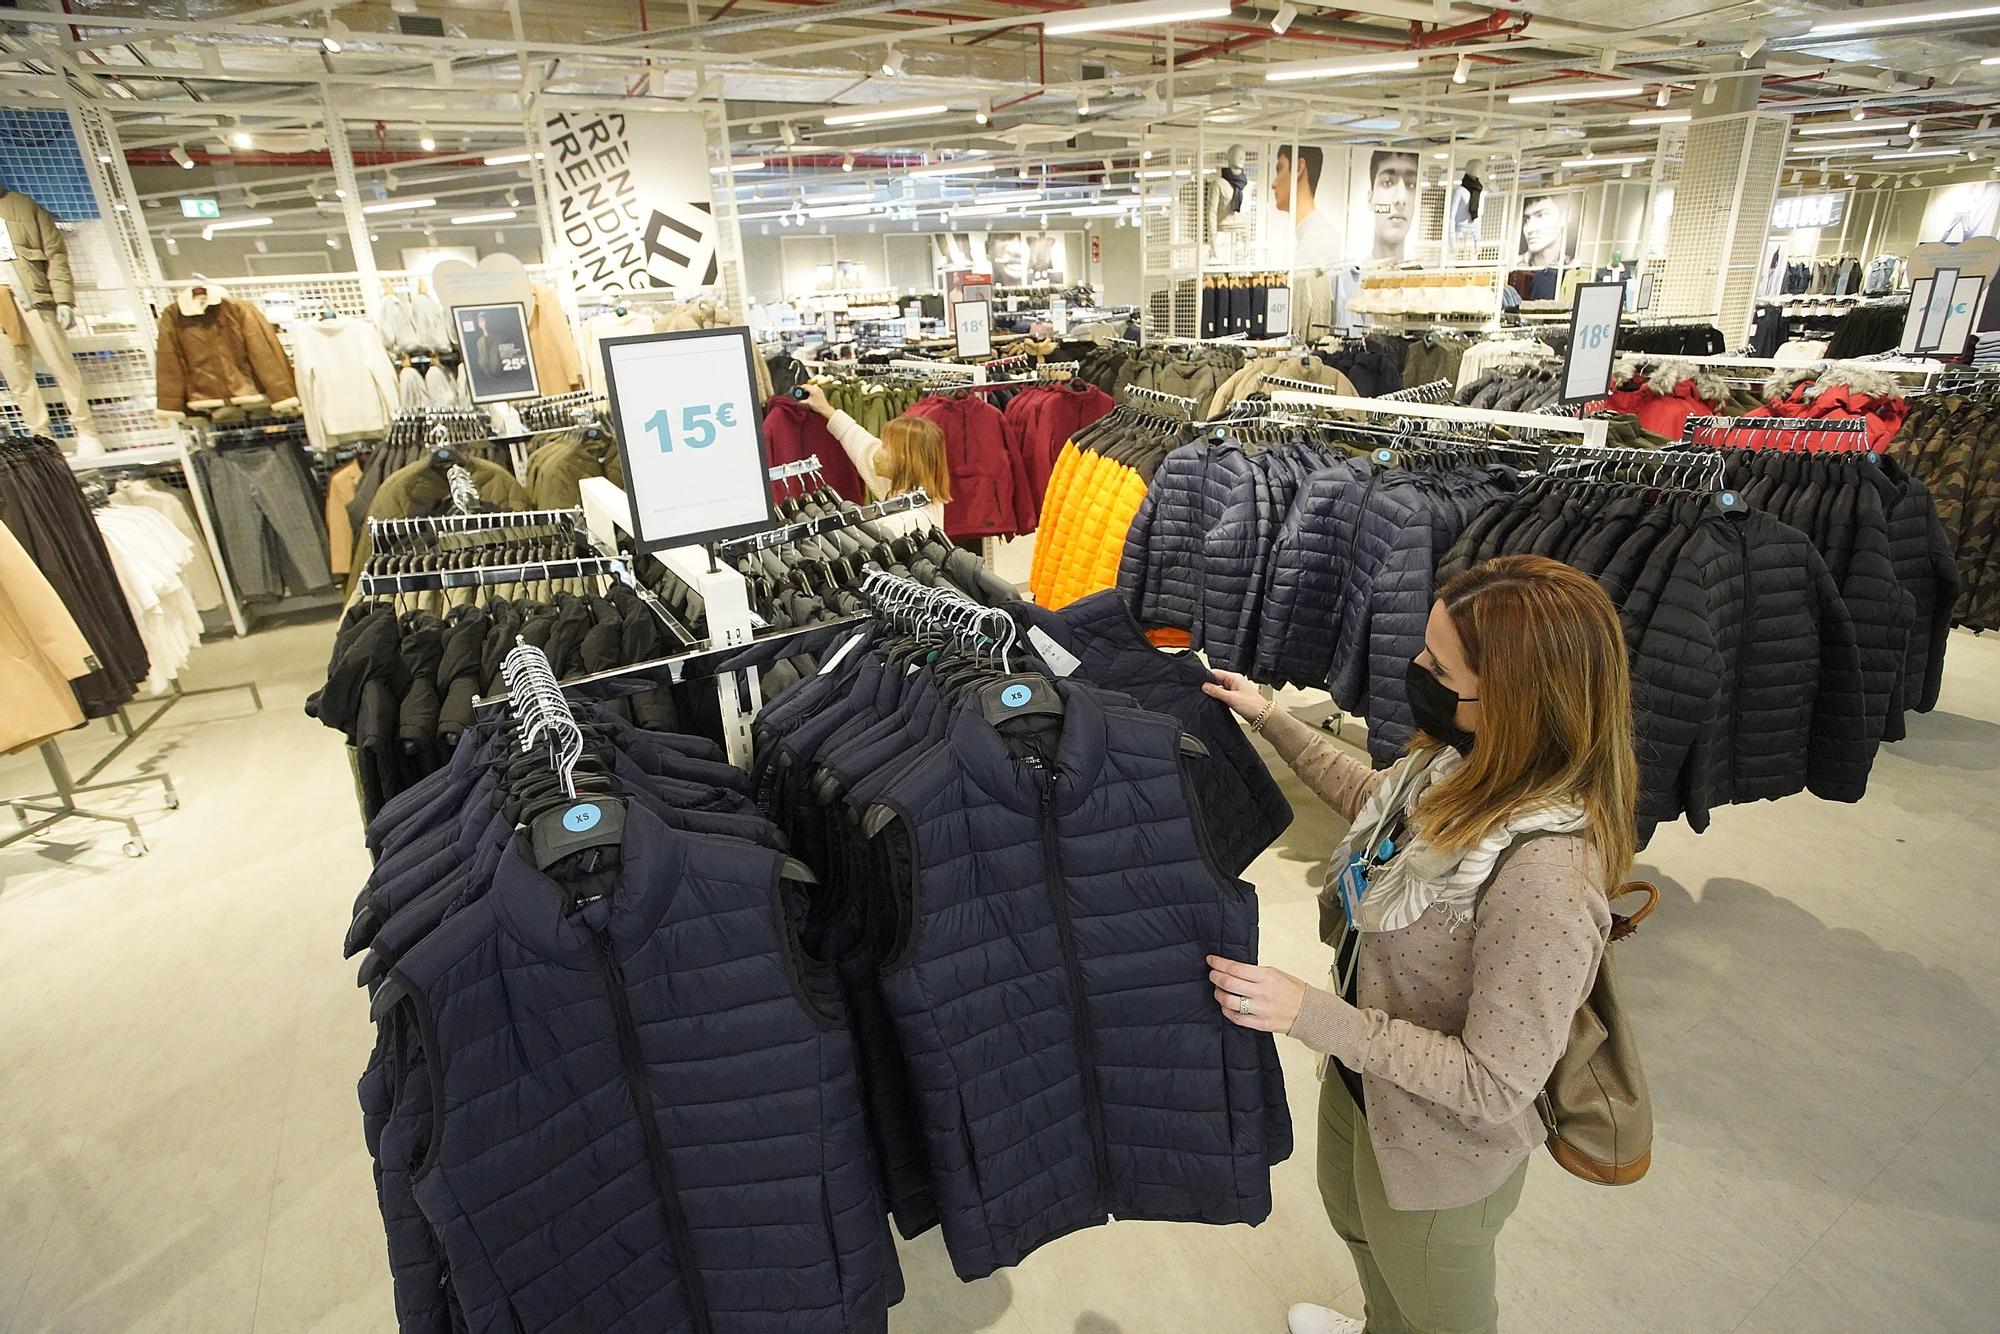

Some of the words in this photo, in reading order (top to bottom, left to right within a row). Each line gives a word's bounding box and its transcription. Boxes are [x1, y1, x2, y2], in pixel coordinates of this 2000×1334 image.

[546, 112, 650, 290] TRENDING
[1579, 323, 1610, 350] 18€
[643, 402, 737, 454] 15€
[1011, 691, 1023, 701] XS
[575, 812, 590, 824] XS
